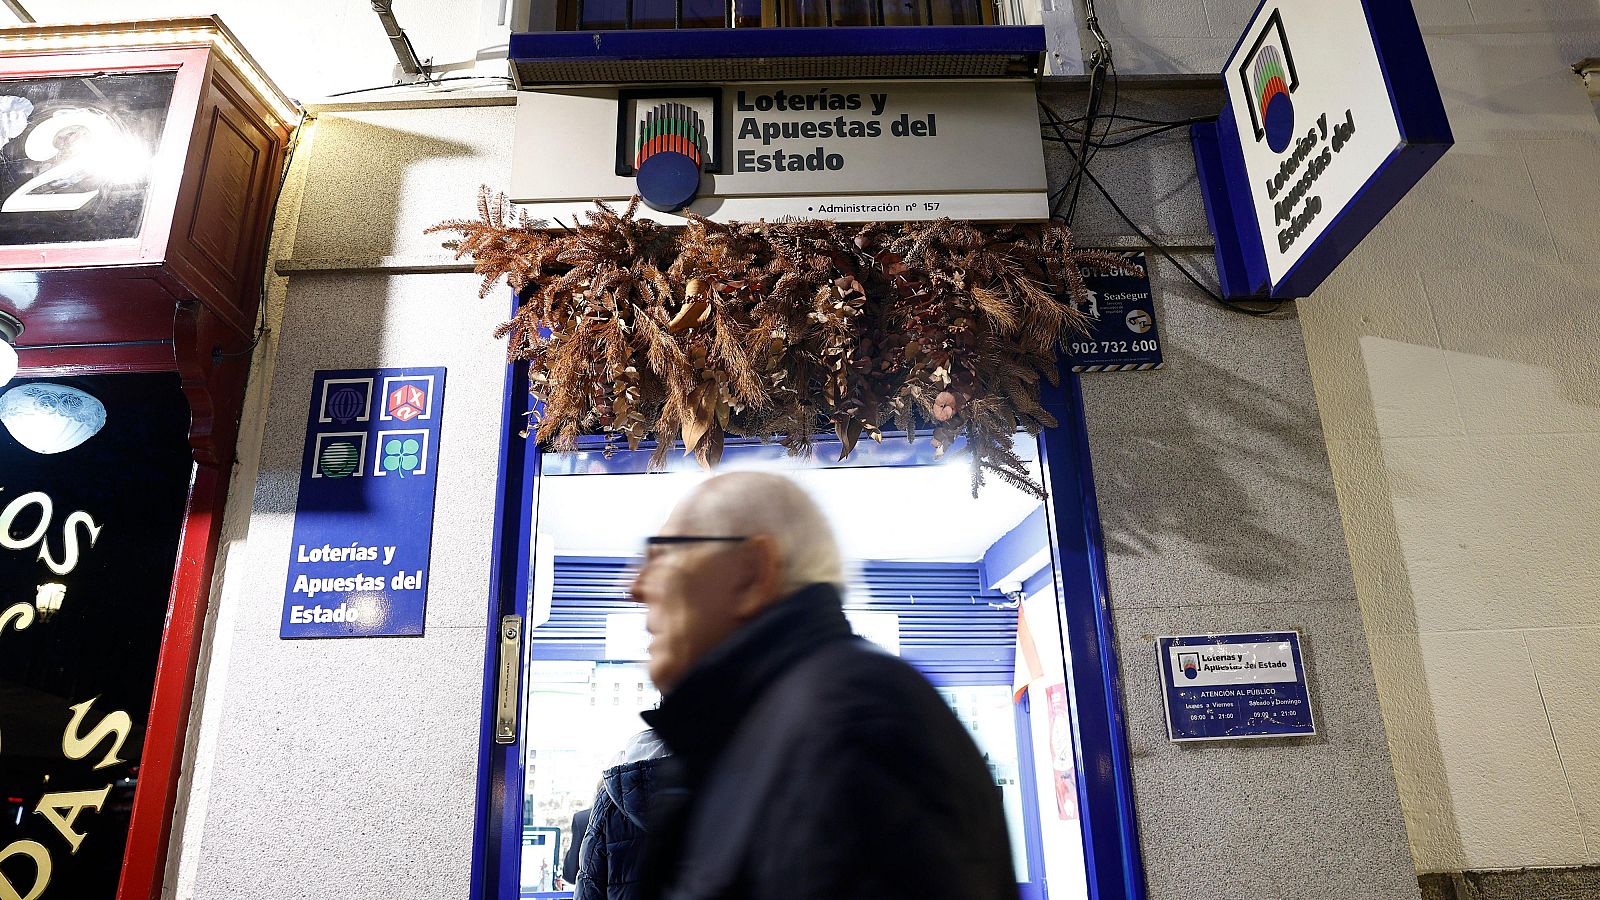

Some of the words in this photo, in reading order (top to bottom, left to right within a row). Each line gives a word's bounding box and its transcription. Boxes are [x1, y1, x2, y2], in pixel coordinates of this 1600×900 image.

[737, 88, 861, 112] Loterías
[870, 93, 888, 116] y
[737, 115, 882, 146] Apuestas
[890, 113, 937, 137] del
[737, 146, 845, 173] Estado
[1265, 127, 1318, 200] Loterías
[1316, 112, 1328, 141] y
[1274, 145, 1332, 227] Apuestas
[1331, 108, 1356, 153] del
[818, 202, 900, 213] Administración
[923, 202, 940, 212] 157
[1277, 195, 1322, 254] Estado
[1103, 291, 1149, 302] SeaSegur
[1072, 342, 1099, 354] 902
[1101, 341, 1128, 353] 732
[1132, 339, 1157, 352] 600
[297, 542, 378, 563] Loterías
[382, 545, 396, 566] y
[293, 572, 385, 598] Apuestas
[391, 570, 423, 591] del
[289, 602, 359, 624] Estado
[1237, 654, 1243, 662] y
[1259, 661, 1287, 669] Estado
[1200, 689, 1235, 698] ATENCIÓN
